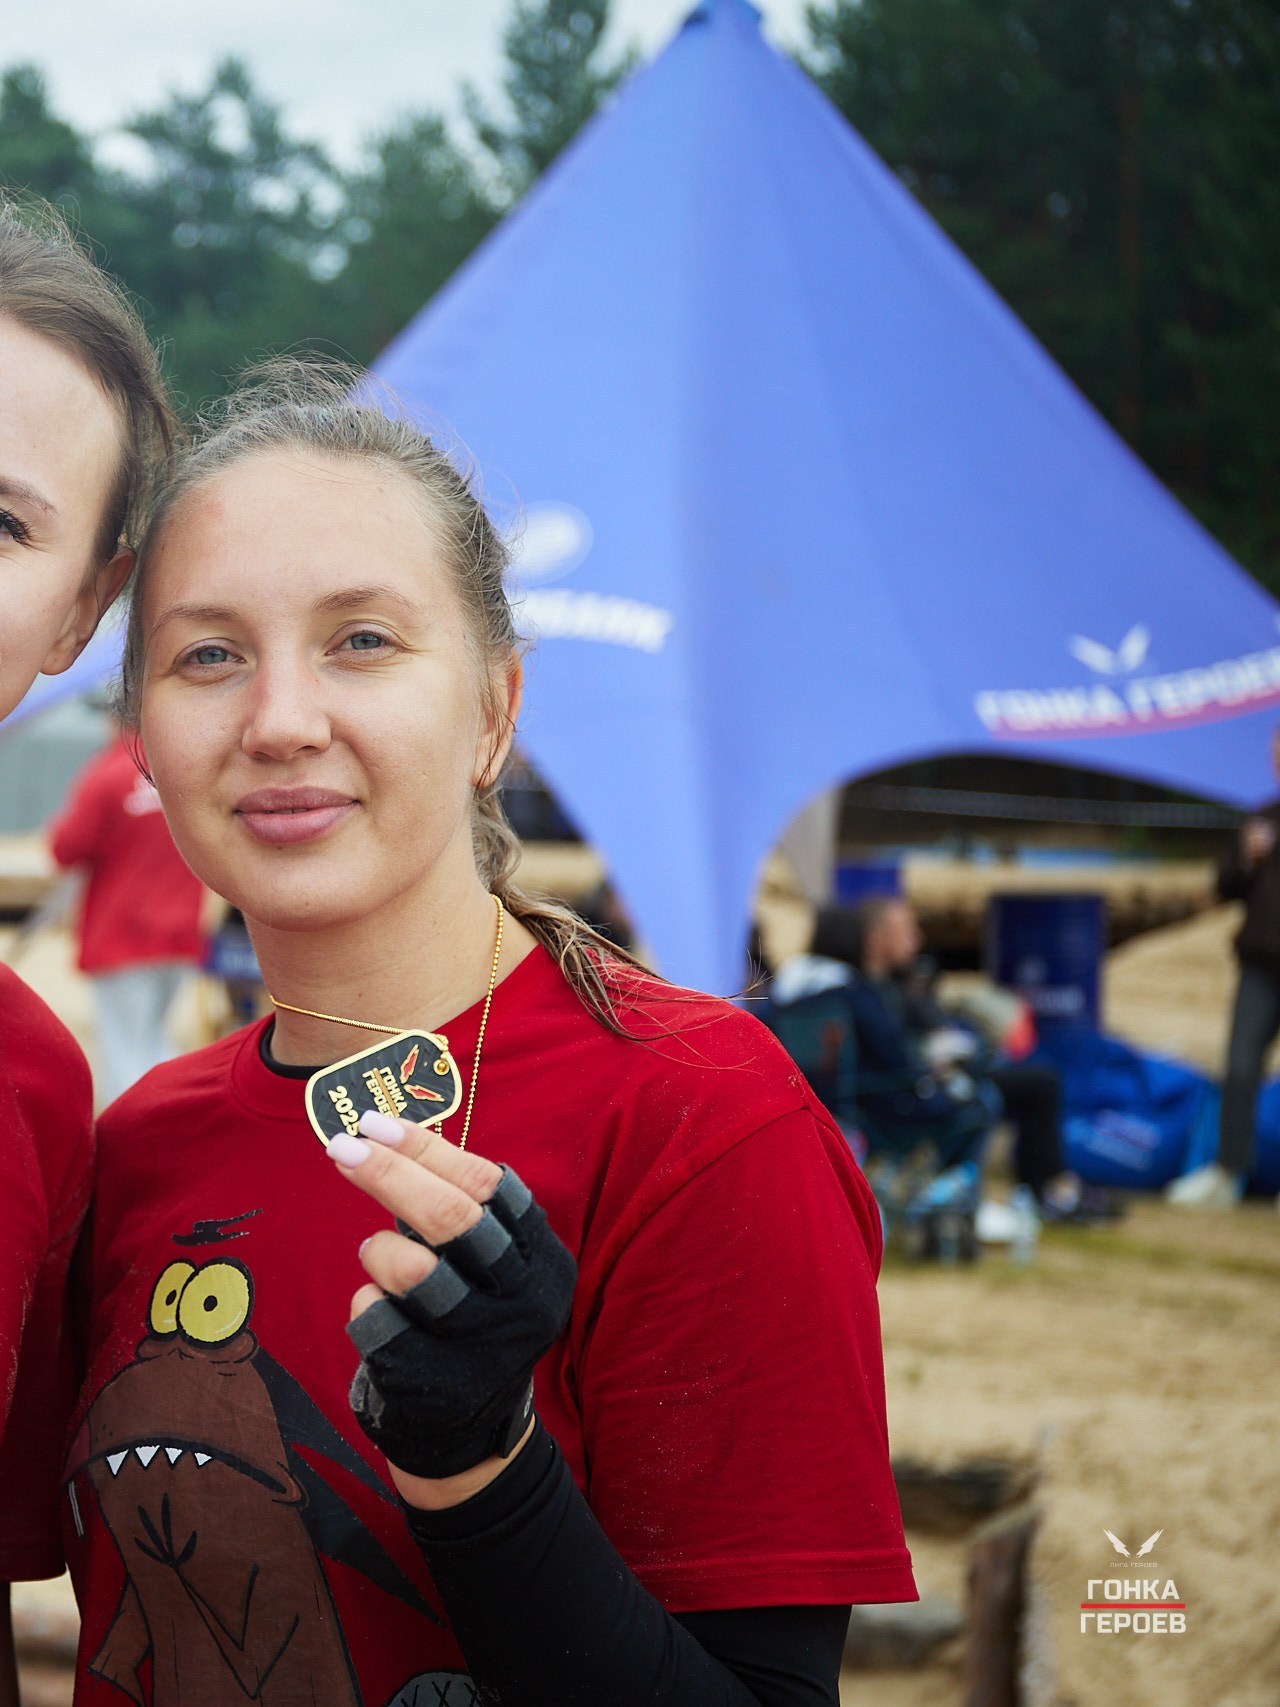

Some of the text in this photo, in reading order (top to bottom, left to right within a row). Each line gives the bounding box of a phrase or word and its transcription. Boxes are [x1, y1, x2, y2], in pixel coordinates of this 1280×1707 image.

[975, 684, 1129, 731] ГОНКА
[362, 1069, 396, 1118] ГЕРОЕ
[379, 1066, 408, 1113] ГОНКА
